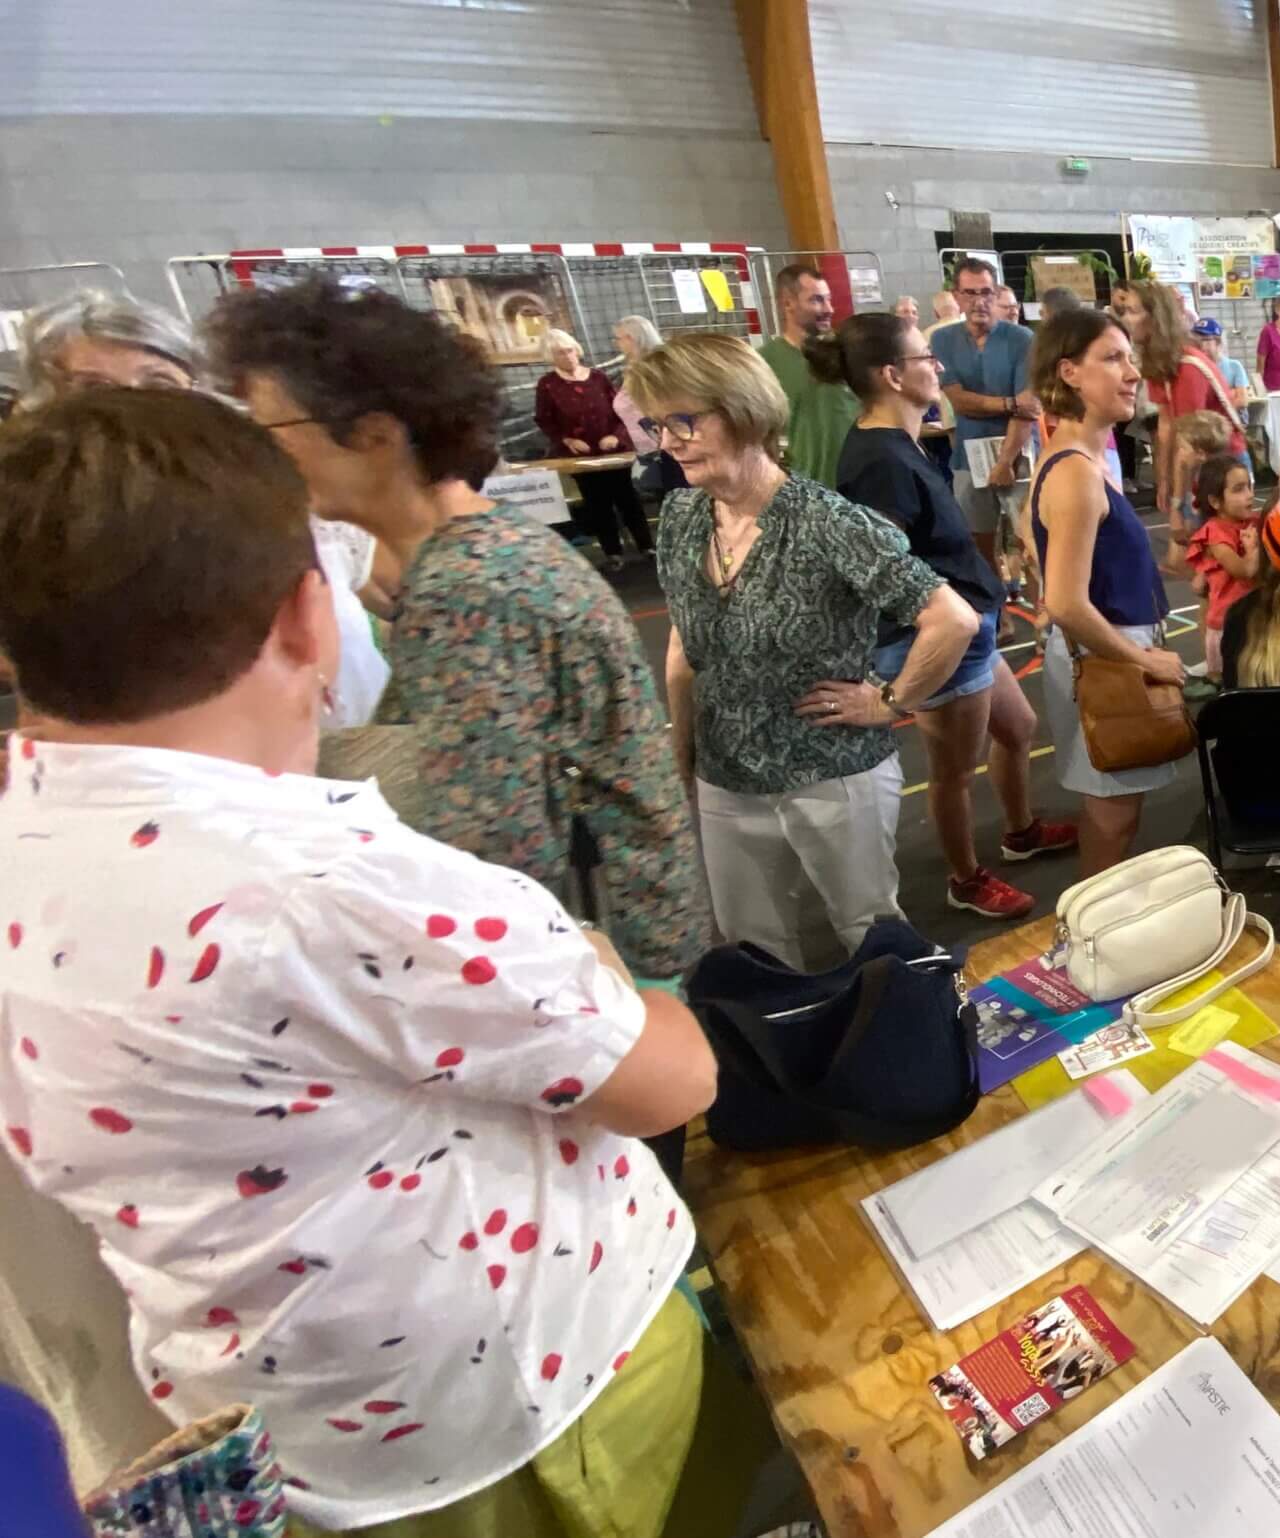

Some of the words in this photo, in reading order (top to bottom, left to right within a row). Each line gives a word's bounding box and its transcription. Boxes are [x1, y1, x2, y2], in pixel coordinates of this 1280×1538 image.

[1018, 1332, 1041, 1362] Yoga
[1020, 1359, 1047, 1388] assis
[1198, 1380, 1231, 1417] NASTIE
